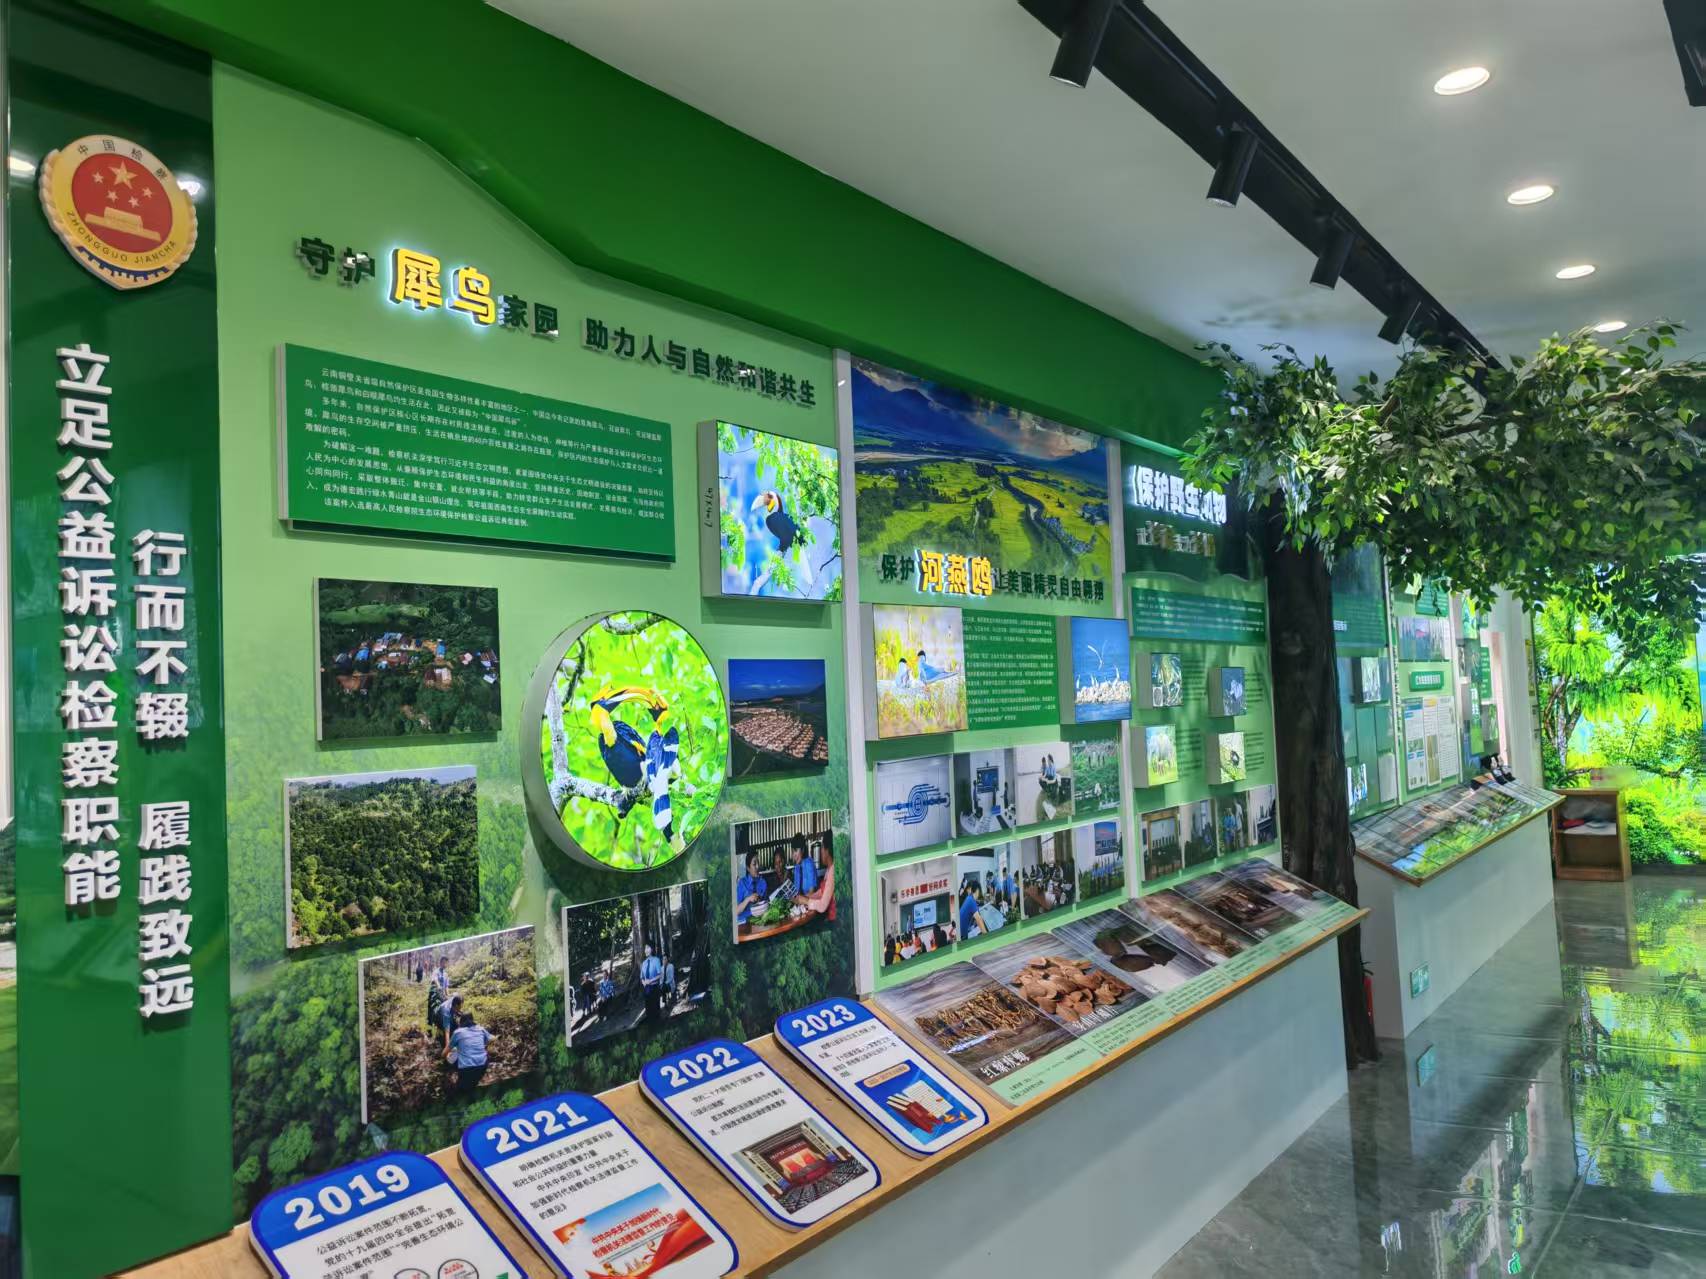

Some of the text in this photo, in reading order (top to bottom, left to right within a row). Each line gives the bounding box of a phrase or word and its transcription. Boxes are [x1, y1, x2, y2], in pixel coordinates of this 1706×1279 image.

[77, 139, 168, 181] 中国检察
[66, 210, 178, 265] ZHONGGUO JIANCHA
[583, 316, 818, 405] 助力人与自然和谐共生
[55, 343, 121, 906] 立足公益诉讼检察职能
[132, 528, 193, 1020] 行而不辍 履践致远
[791, 1004, 856, 1038] 2023
[660, 1047, 740, 1088] 2022
[486, 1102, 588, 1154] 2021
[512, 1149, 599, 1188] 和社会公共利益的重要力量
[529, 1158, 640, 1210] 加强新时代检察机关法律监督工作
[536, 1148, 630, 1192] 中共中央印发《中共中央关于
[284, 1164, 410, 1231] 2019
[538, 1204, 568, 1220] 的意见》
[316, 1204, 432, 1255] 公益诉讼案件范围不断拓宽。
